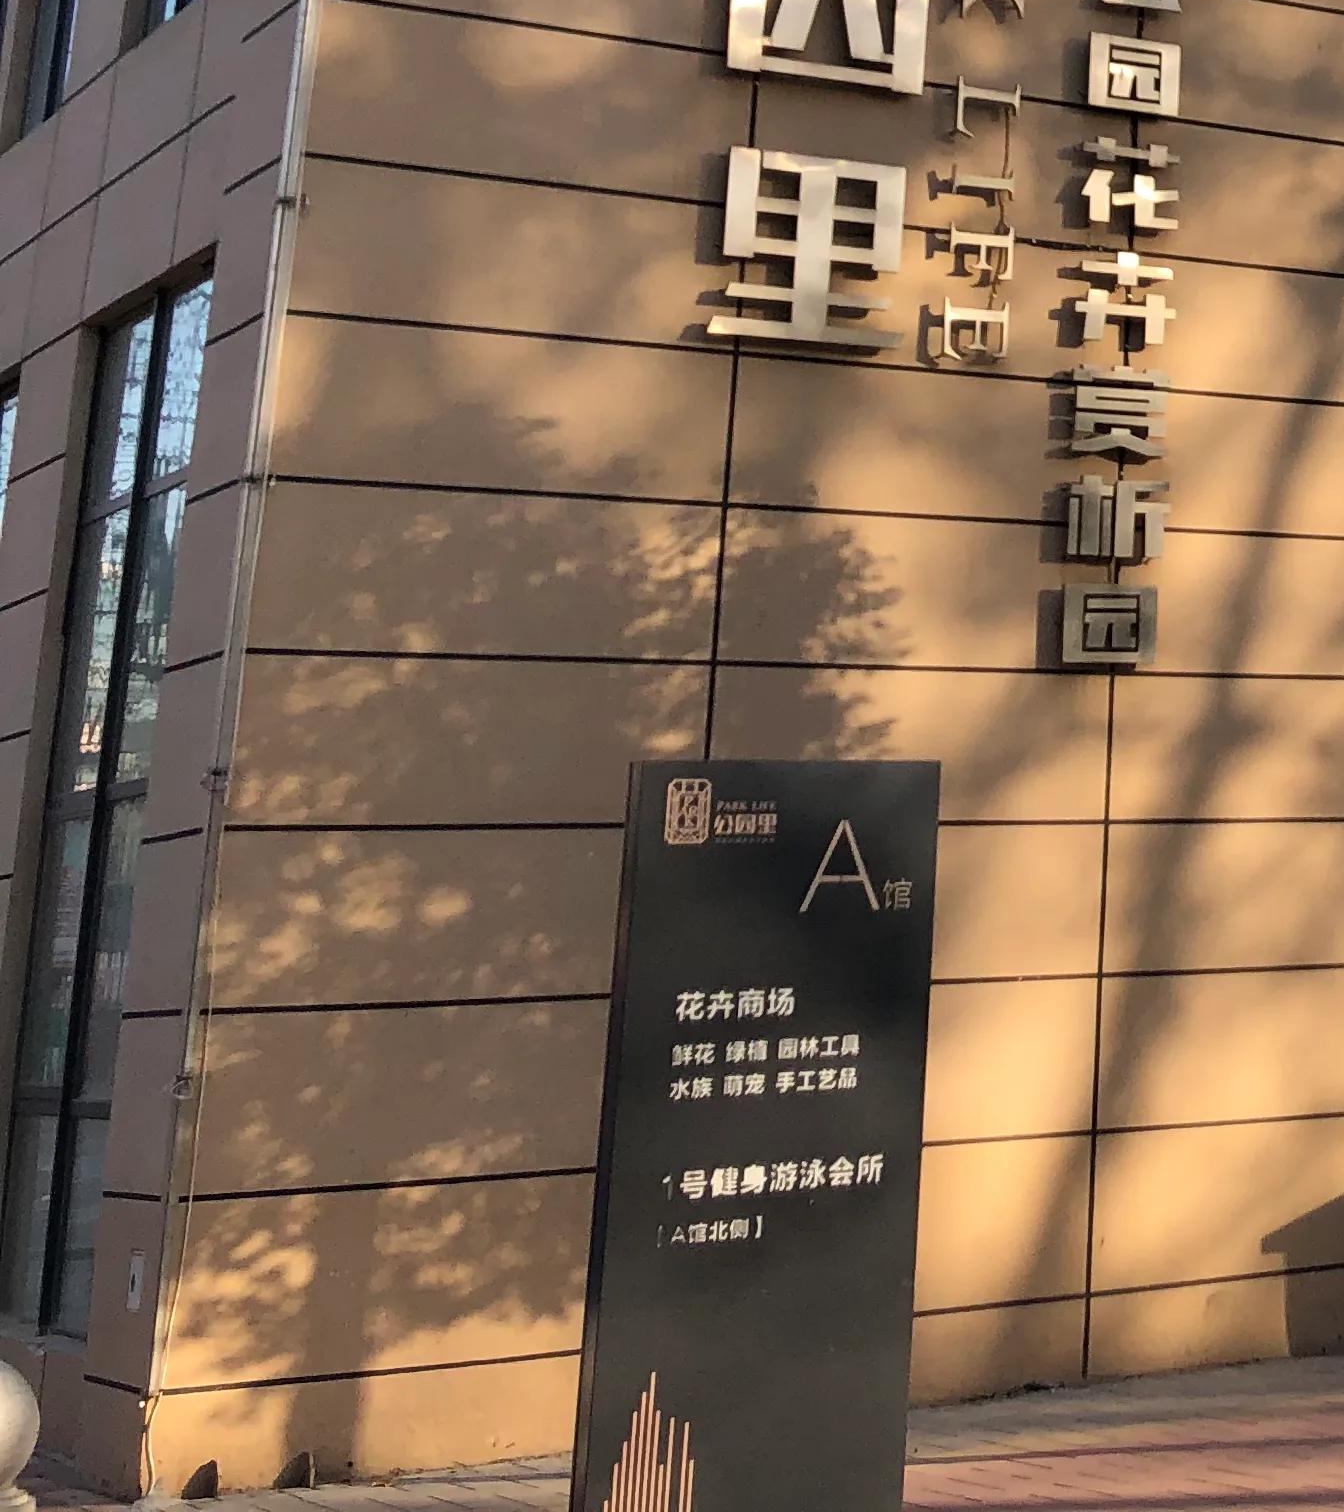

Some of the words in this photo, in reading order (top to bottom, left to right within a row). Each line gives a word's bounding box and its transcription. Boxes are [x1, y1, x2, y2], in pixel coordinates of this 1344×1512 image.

[943, 74, 1022, 362] LIFE
[674, 987, 797, 1023] 花卉商场
[671, 1041, 716, 1067] 鲜花
[725, 1039, 769, 1064] 绿植
[777, 1033, 861, 1061] 园林工具
[669, 1076, 714, 1101] 水族
[723, 1072, 767, 1097] 萌宠
[775, 1067, 858, 1094] 手工艺品
[661, 1153, 885, 1201] 1号健身游泳会所
